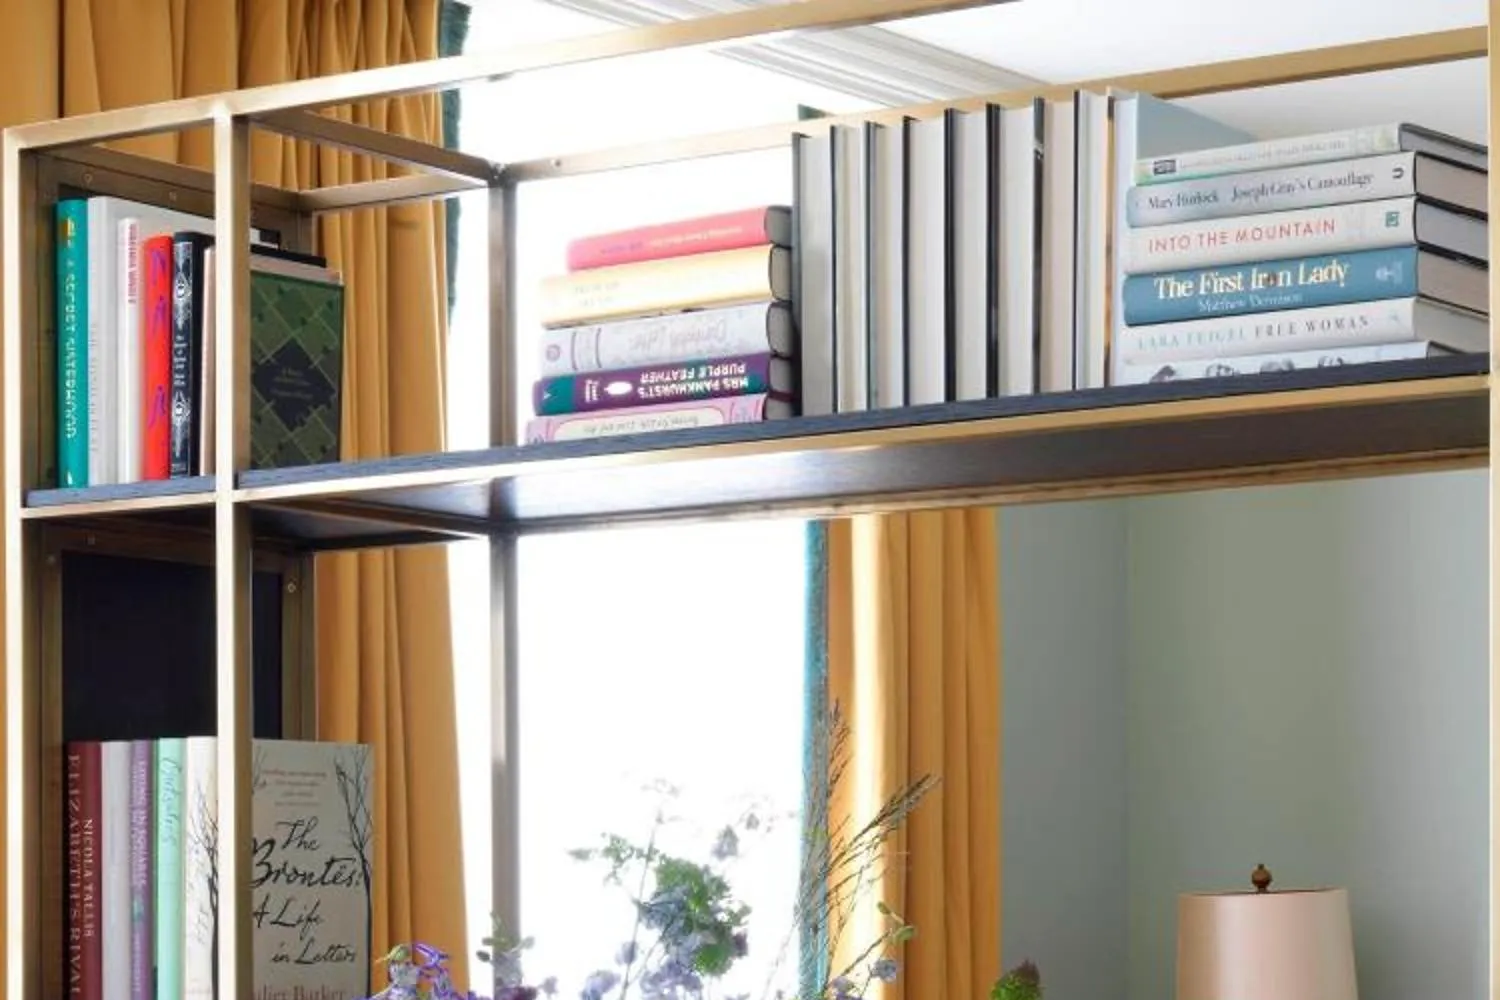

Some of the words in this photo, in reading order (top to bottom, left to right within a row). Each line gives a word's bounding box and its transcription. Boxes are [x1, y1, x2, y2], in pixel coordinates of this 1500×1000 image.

[1148, 233, 1192, 255] INTO
[1198, 230, 1228, 247] THE
[1235, 218, 1336, 244] MOUNTAIN
[1154, 274, 1194, 301] The
[1198, 268, 1245, 296] First
[1298, 258, 1351, 290] Lady
[1254, 321, 1298, 340] FREE
[1304, 315, 1369, 335] WOMAN
[639, 366, 697, 385] FEATHER
[700, 362, 747, 378] PURPLE
[67, 753, 82, 920] ELIZABETH'S
[82, 817, 94, 879] NICOLA
[275, 815, 321, 851] The
[270, 898, 327, 941] Life
[68, 926, 83, 995] RIVAL
[270, 942, 291, 964] in
[294, 942, 356, 966] Letters
